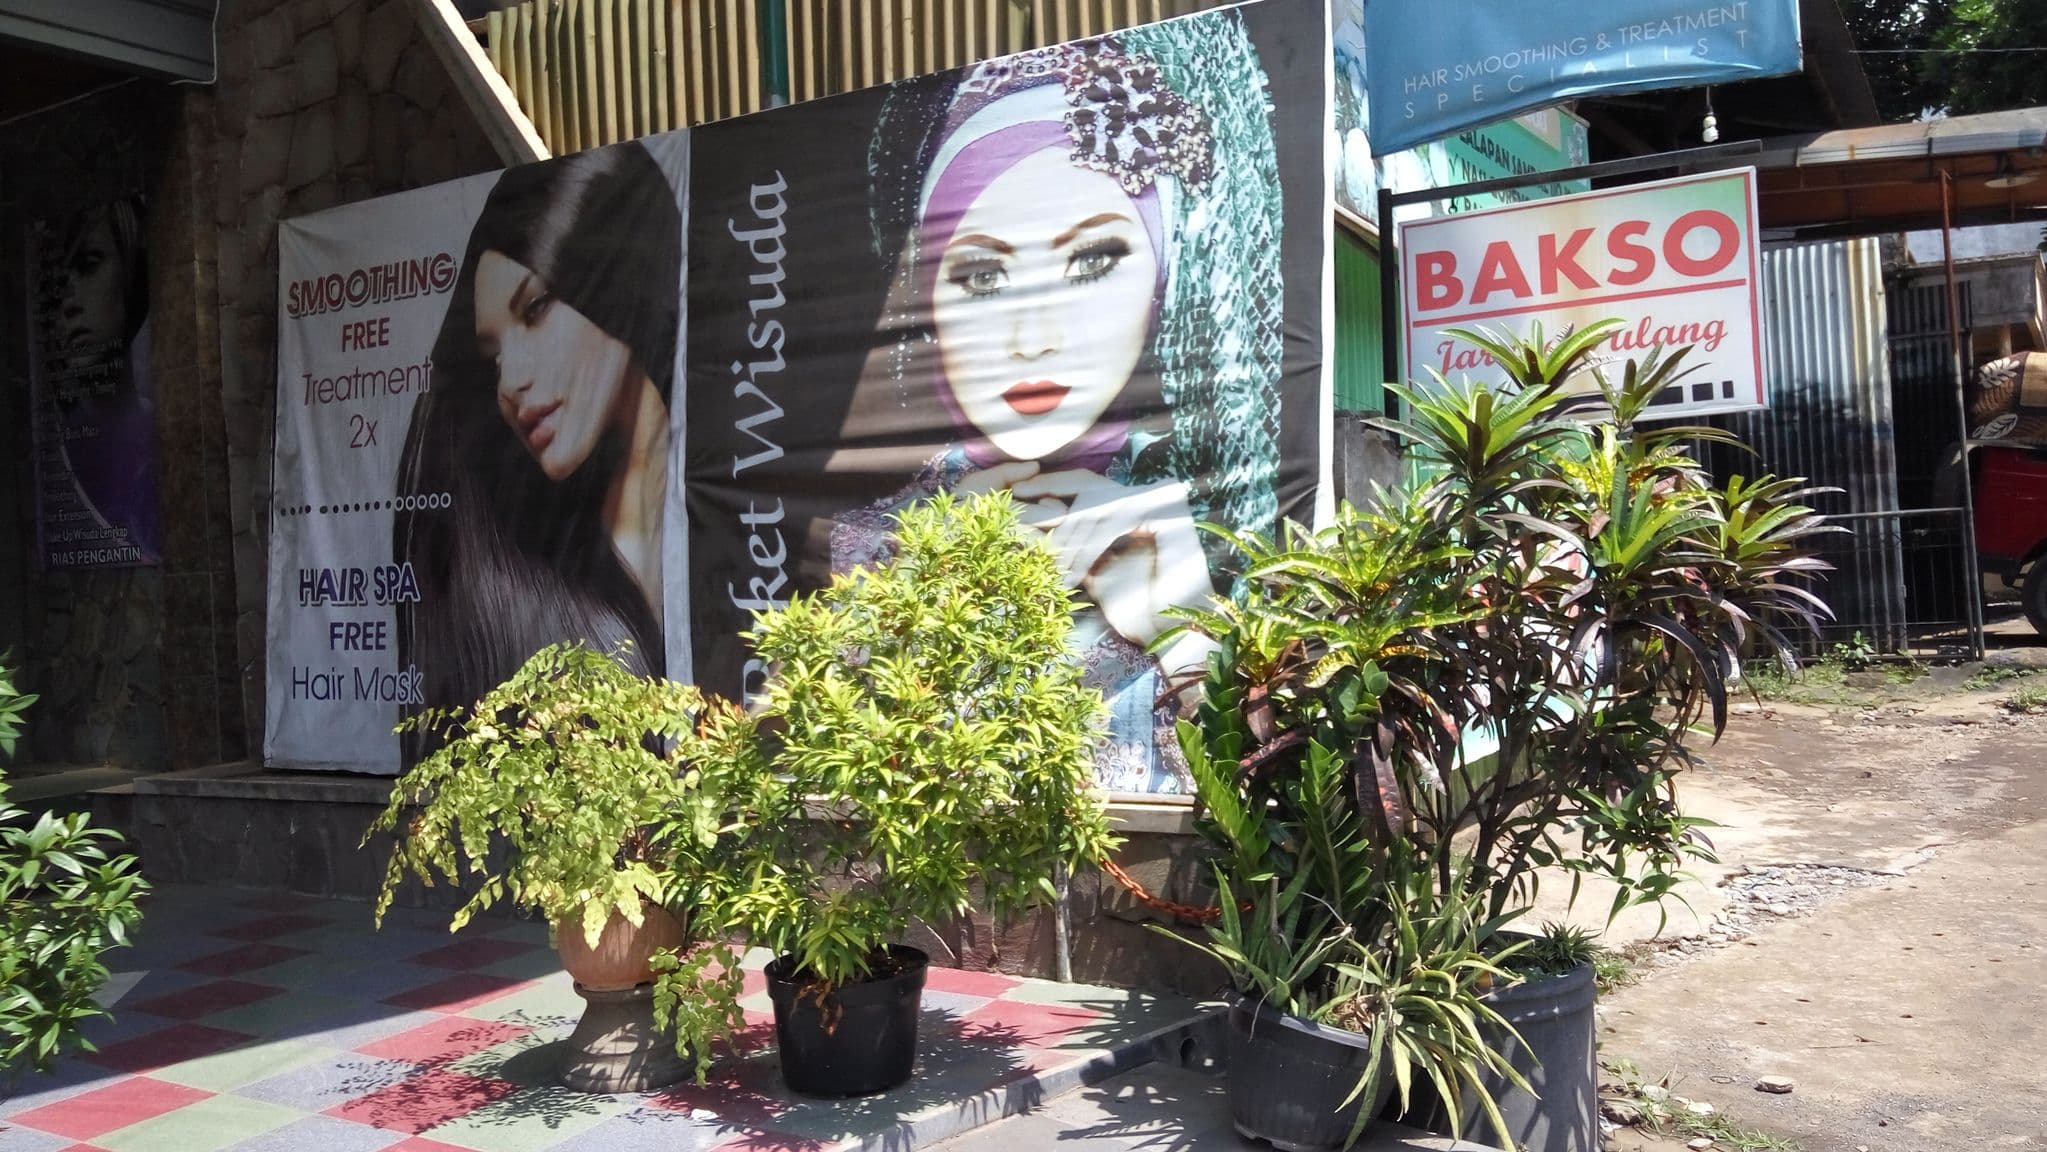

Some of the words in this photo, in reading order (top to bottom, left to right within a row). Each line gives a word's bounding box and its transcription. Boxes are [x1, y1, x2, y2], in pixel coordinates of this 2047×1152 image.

[1404, 68, 1448, 95] HAIR
[1453, 37, 1588, 82] SMOOTHING
[1595, 31, 1612, 52] &
[1617, 1, 1748, 45] TREATMENT
[1415, 209, 1741, 312] BAKSO
[287, 253, 457, 318] SMOOTHING
[341, 317, 391, 352] FREE
[728, 169, 788, 480] Wisuda
[1609, 316, 1729, 352] ulang
[302, 355, 432, 406] Treatment
[350, 414, 378, 449] 2x
[51, 551, 75, 566] RIAS
[77, 546, 141, 565] PENGANTIN
[299, 567, 368, 606] HAIR
[373, 562, 422, 606] SPA
[728, 496, 790, 712] Pket
[329, 621, 387, 650] FREE
[292, 666, 344, 701] Hair
[354, 664, 424, 703] Mask
